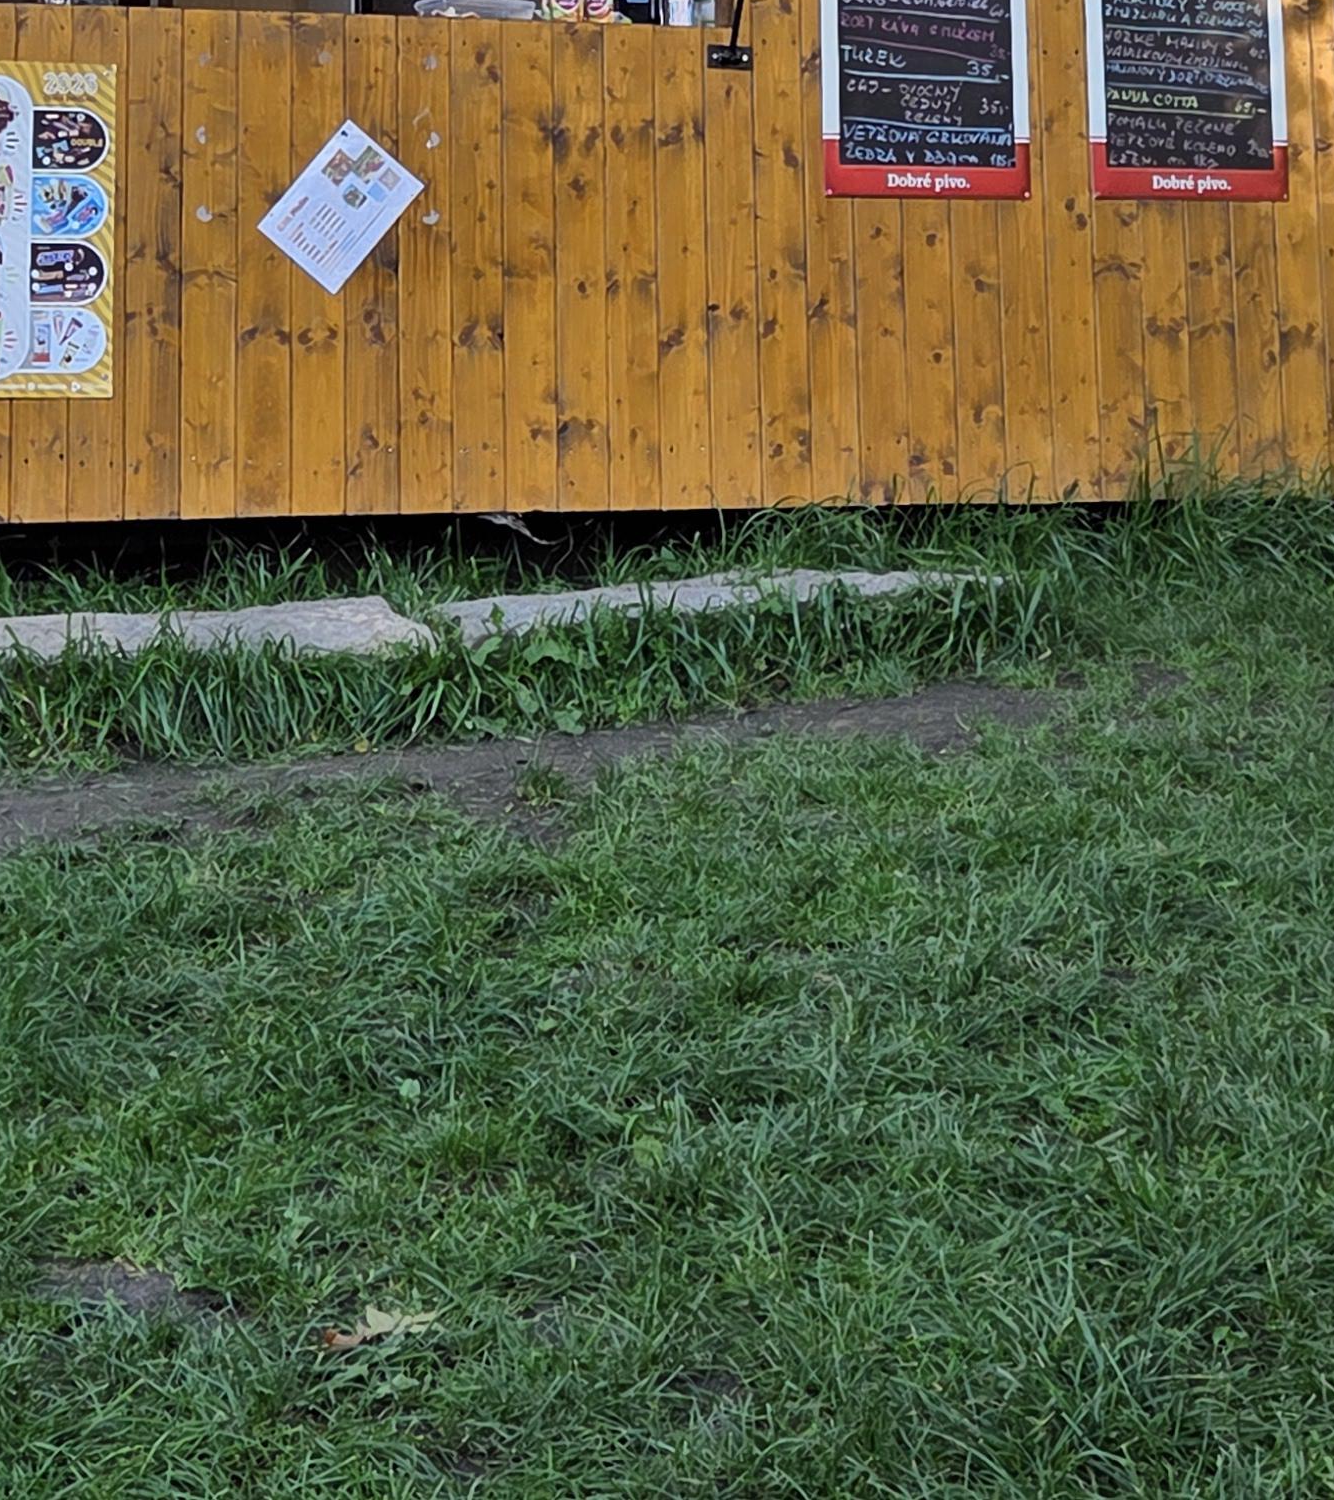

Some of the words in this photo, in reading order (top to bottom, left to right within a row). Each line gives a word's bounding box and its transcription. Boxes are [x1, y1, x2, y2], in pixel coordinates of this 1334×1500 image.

[840, 44, 906, 68] TUREK
[887, 173, 932, 189] Dobré
[935, 176, 971, 193] pivo.
[1152, 175, 1194, 190] Dobré
[1197, 177, 1231, 193] pivo.
